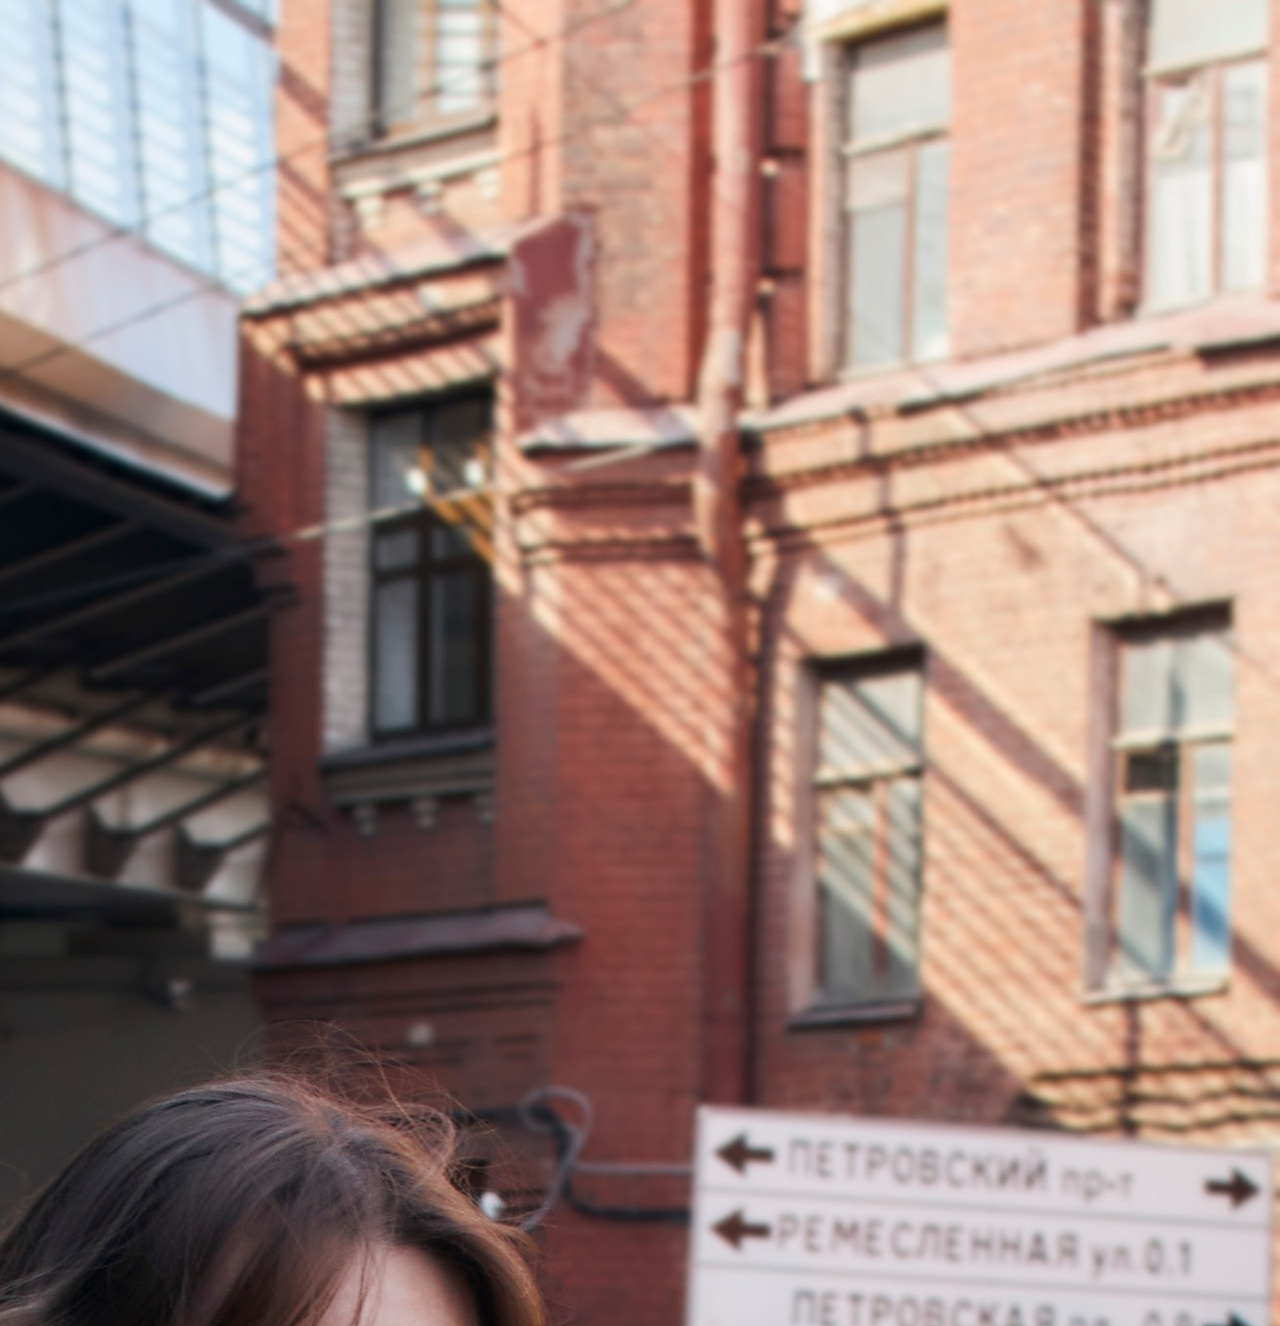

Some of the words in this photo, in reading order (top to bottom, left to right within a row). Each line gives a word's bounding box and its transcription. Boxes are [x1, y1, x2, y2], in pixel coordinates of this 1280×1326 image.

[786, 1137, 1048, 1191] ПЕТРОВСКИЙ
[1061, 1168, 1134, 1203] пр-т
[776, 1213, 1078, 1268] РЕМЕСЛЕННАЯ
